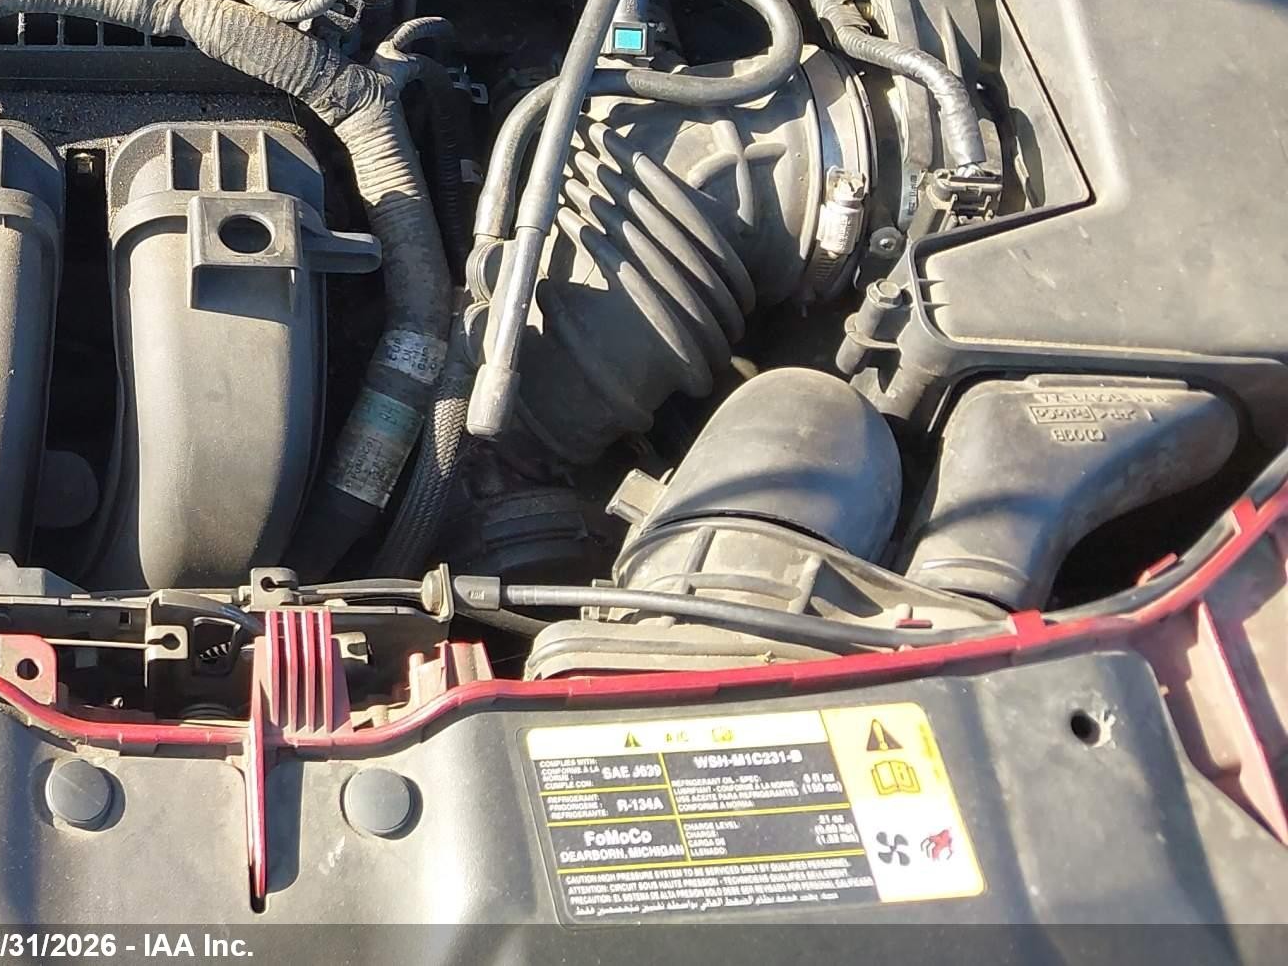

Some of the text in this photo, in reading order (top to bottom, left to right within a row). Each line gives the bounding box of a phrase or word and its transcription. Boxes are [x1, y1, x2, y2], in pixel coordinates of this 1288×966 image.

[602, 763, 661, 780] SAE J639
[616, 796, 664, 812] R-134A
[583, 826, 652, 847] FoMoCo
[559, 843, 684, 863] DEARBORN, MICHIGAN
